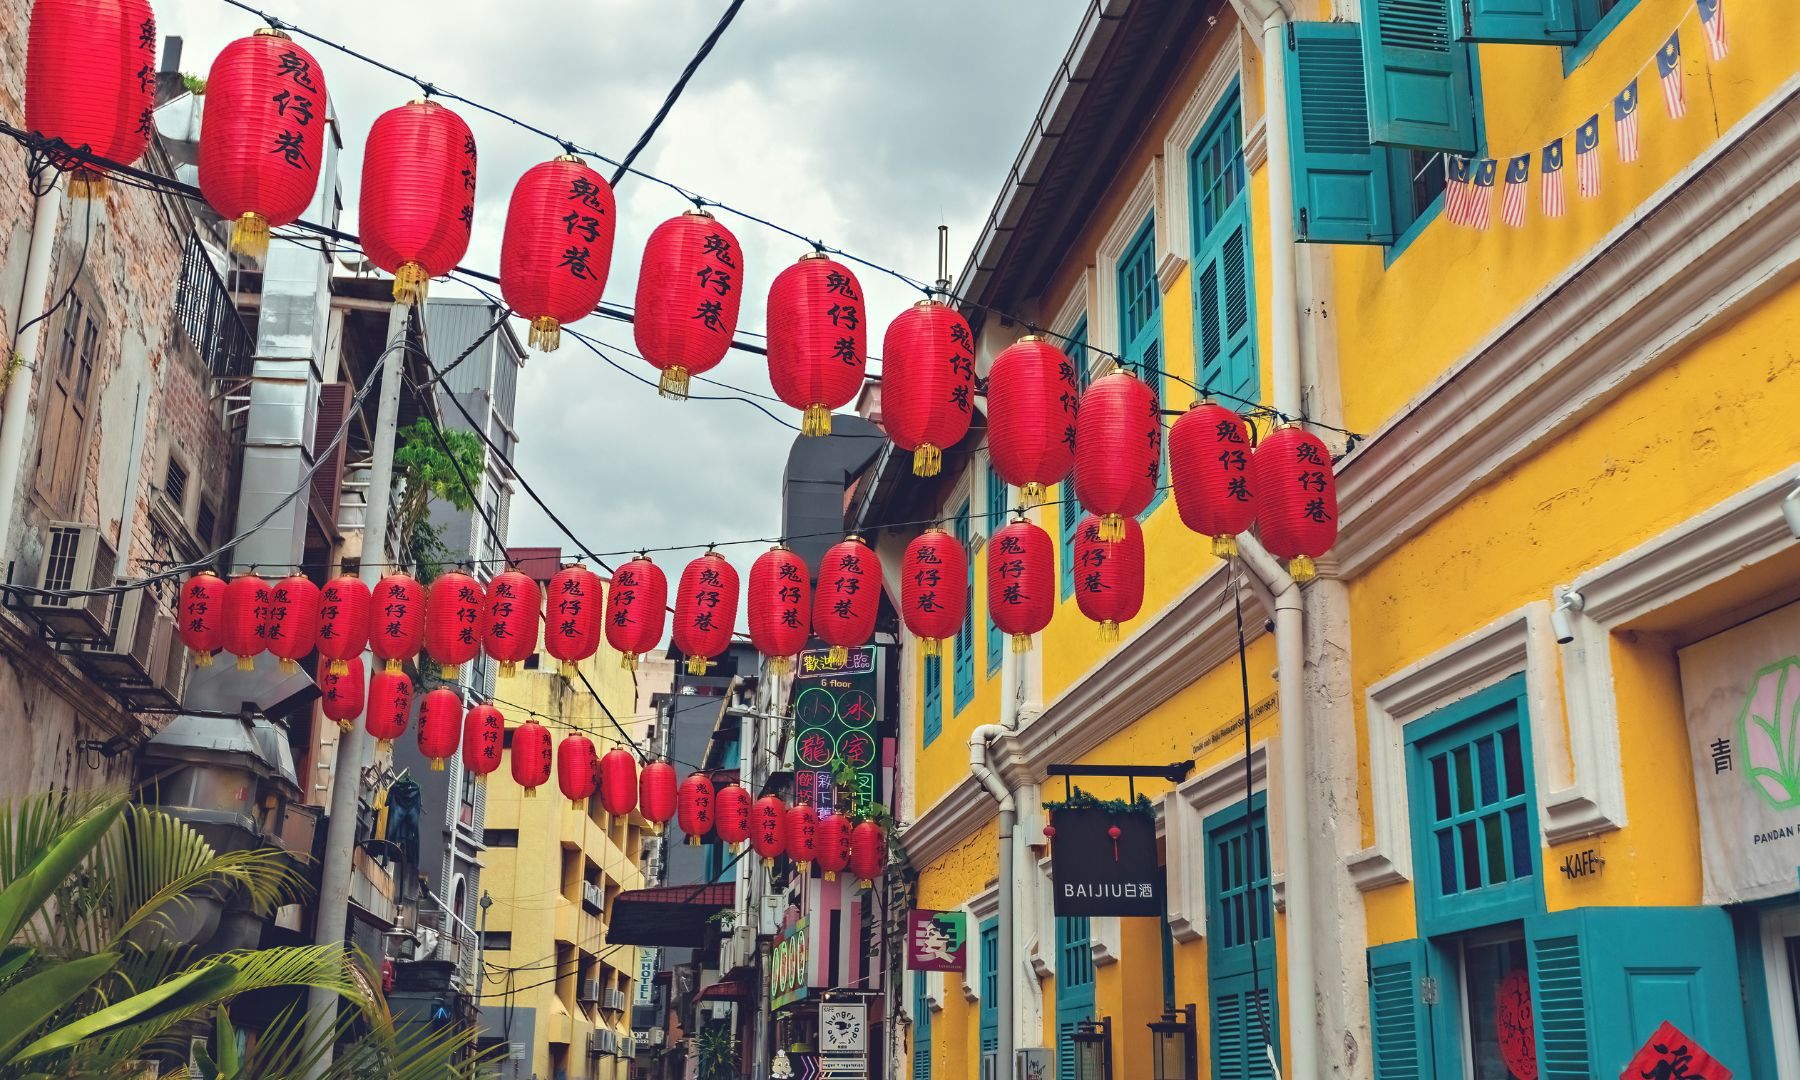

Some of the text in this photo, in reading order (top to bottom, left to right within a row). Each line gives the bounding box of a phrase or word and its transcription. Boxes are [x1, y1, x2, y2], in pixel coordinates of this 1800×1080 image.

[830, 679, 852, 689] floor
[1710, 738, 1733, 775] 青
[1754, 826, 1794, 845] PANDAN
[1565, 850, 1596, 879] KAFE
[640, 963, 651, 999] HOTEL
[825, 1011, 861, 1045] the hungry tapir
